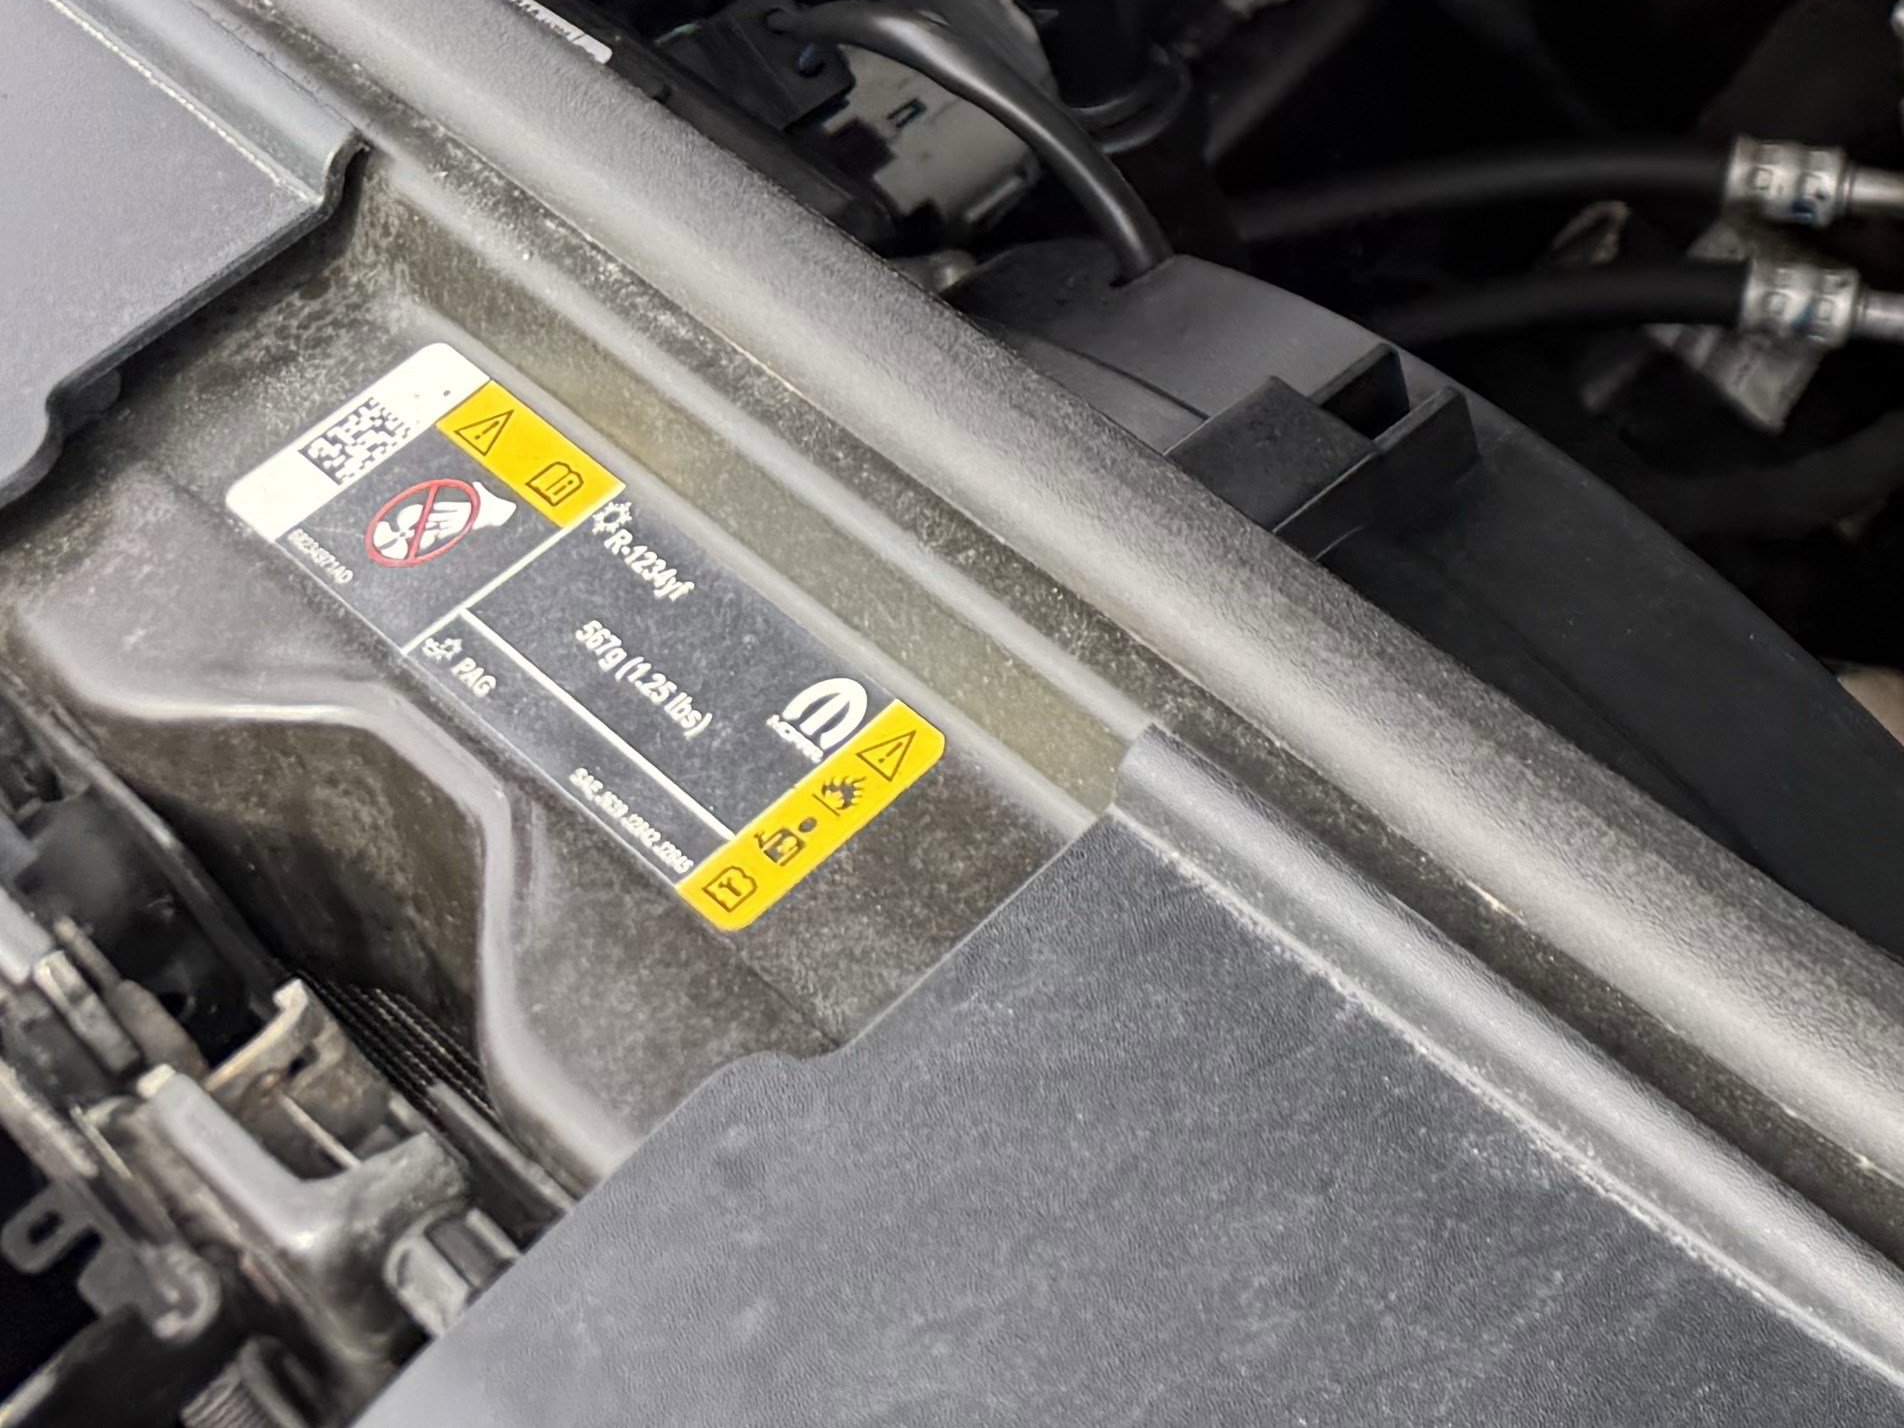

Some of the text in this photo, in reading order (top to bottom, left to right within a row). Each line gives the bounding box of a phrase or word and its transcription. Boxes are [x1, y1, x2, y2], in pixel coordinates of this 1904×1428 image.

[603, 528, 695, 601] R-1234yf
[451, 657, 497, 698] PAG
[575, 619, 713, 739] 567g (1.25 lbs)
